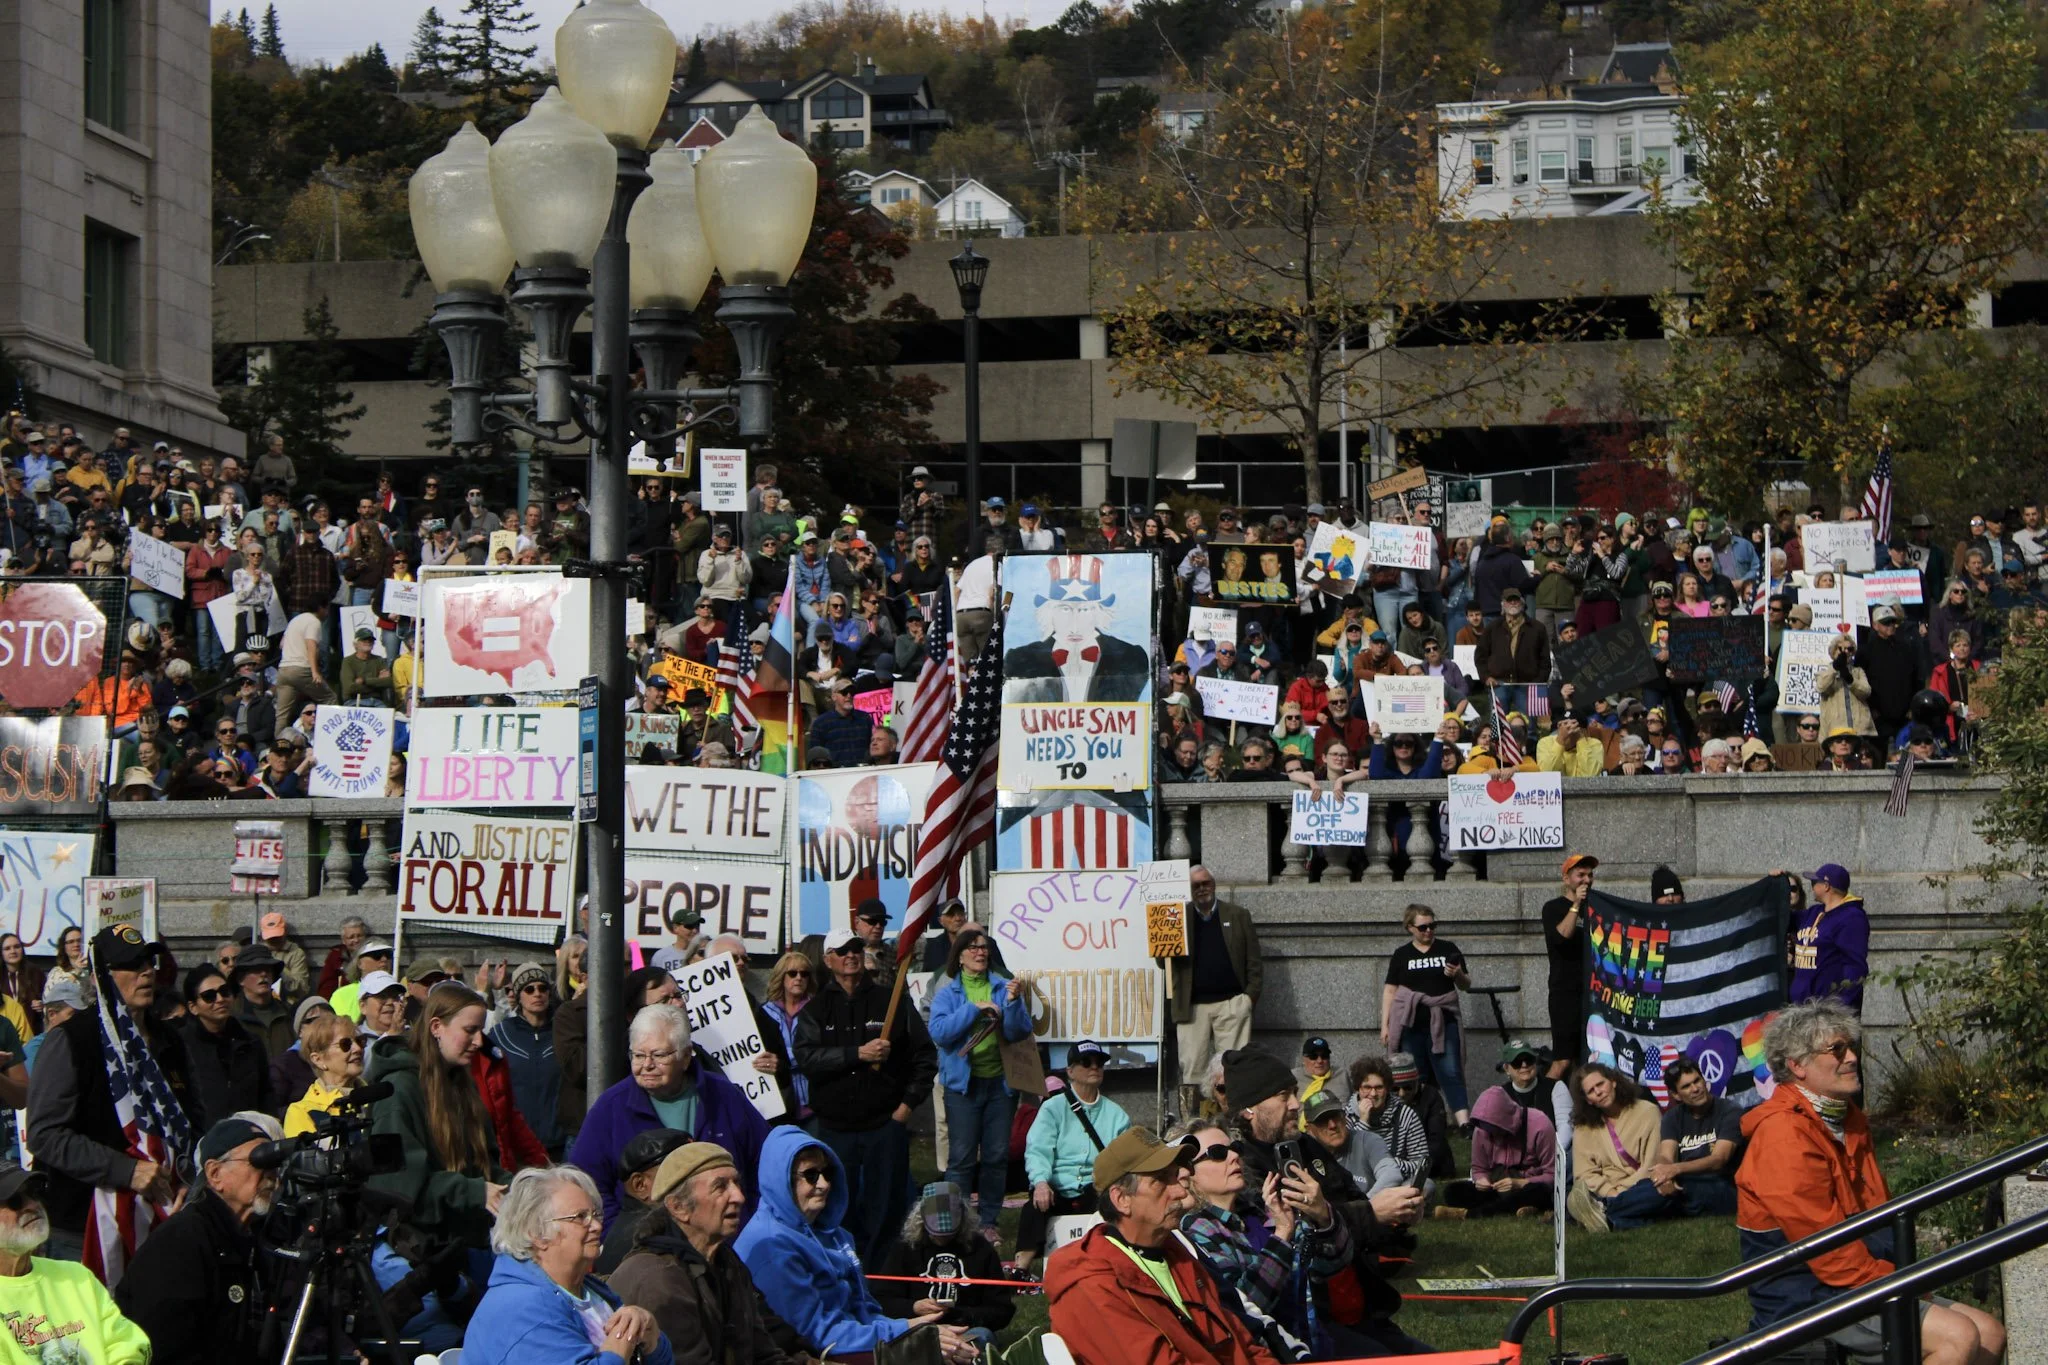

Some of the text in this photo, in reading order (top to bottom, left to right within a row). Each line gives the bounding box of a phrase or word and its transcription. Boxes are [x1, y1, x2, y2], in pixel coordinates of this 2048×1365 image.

[1413, 530, 1430, 542] ALL
[1807, 525, 1860, 539] NO KINGS
[1370, 537, 1403, 555] Liberty
[1411, 543, 1428, 555] ALL
[1371, 551, 1402, 563] Justice
[1410, 555, 1428, 567] ALL
[1217, 580, 1289, 598] BESTIES
[1824, 597, 1840, 605] Here
[0, 620, 97, 667] STOP
[1787, 633, 1829, 644] DEFEND
[1788, 643, 1828, 654] LIBERT
[684, 661, 699, 677] THE
[1199, 680, 1271, 693] WITH LIBERTY
[1240, 706, 1261, 717] ALL
[322, 710, 387, 737] PRO-AMERICA
[625, 714, 680, 735] O KINGS
[1020, 707, 1136, 736] UNCLE SAM
[451, 713, 541, 754] LIFE
[1026, 734, 1122, 762] NEEDS YOU
[1773, 745, 1793, 759] NO
[315, 765, 383, 793] ANTI-TRUMP
[416, 756, 576, 801] LIBERTY
[1056, 762, 1087, 780] TO
[1450, 777, 1486, 792] Because
[1296, 793, 1360, 815] HANDS
[1460, 788, 1561, 809] WE AMERICA
[625, 781, 692, 834] WE
[701, 784, 777, 837] THE
[1306, 813, 1342, 829] OFF
[406, 824, 570, 864] AND JUSTICE
[1294, 828, 1367, 843] our FREEDOM
[1461, 825, 1496, 847] NO
[1518, 826, 1561, 847] KINGS
[235, 838, 284, 861] LIES
[101, 889, 116, 901] NO
[120, 884, 144, 899] KINGS
[230, 873, 280, 895] LIES
[401, 859, 562, 918] FOR ALL
[1139, 883, 1188, 905] Resistance
[100, 906, 113, 916] NO
[624, 879, 771, 940] PEOPLE
[997, 872, 1139, 949] PROTECT
[1149, 903, 1177, 918] No
[1062, 917, 1128, 949] our
[1149, 917, 1183, 932] Kings
[1150, 928, 1183, 943] Since
[1151, 942, 1183, 957] 1776
[1408, 956, 1446, 970] RESIST
[688, 994, 733, 1033] ENTS
[1634, 1000, 1660, 1019] HERE
[711, 1034, 761, 1067] RNING
[1070, 1227, 1083, 1239] NO
